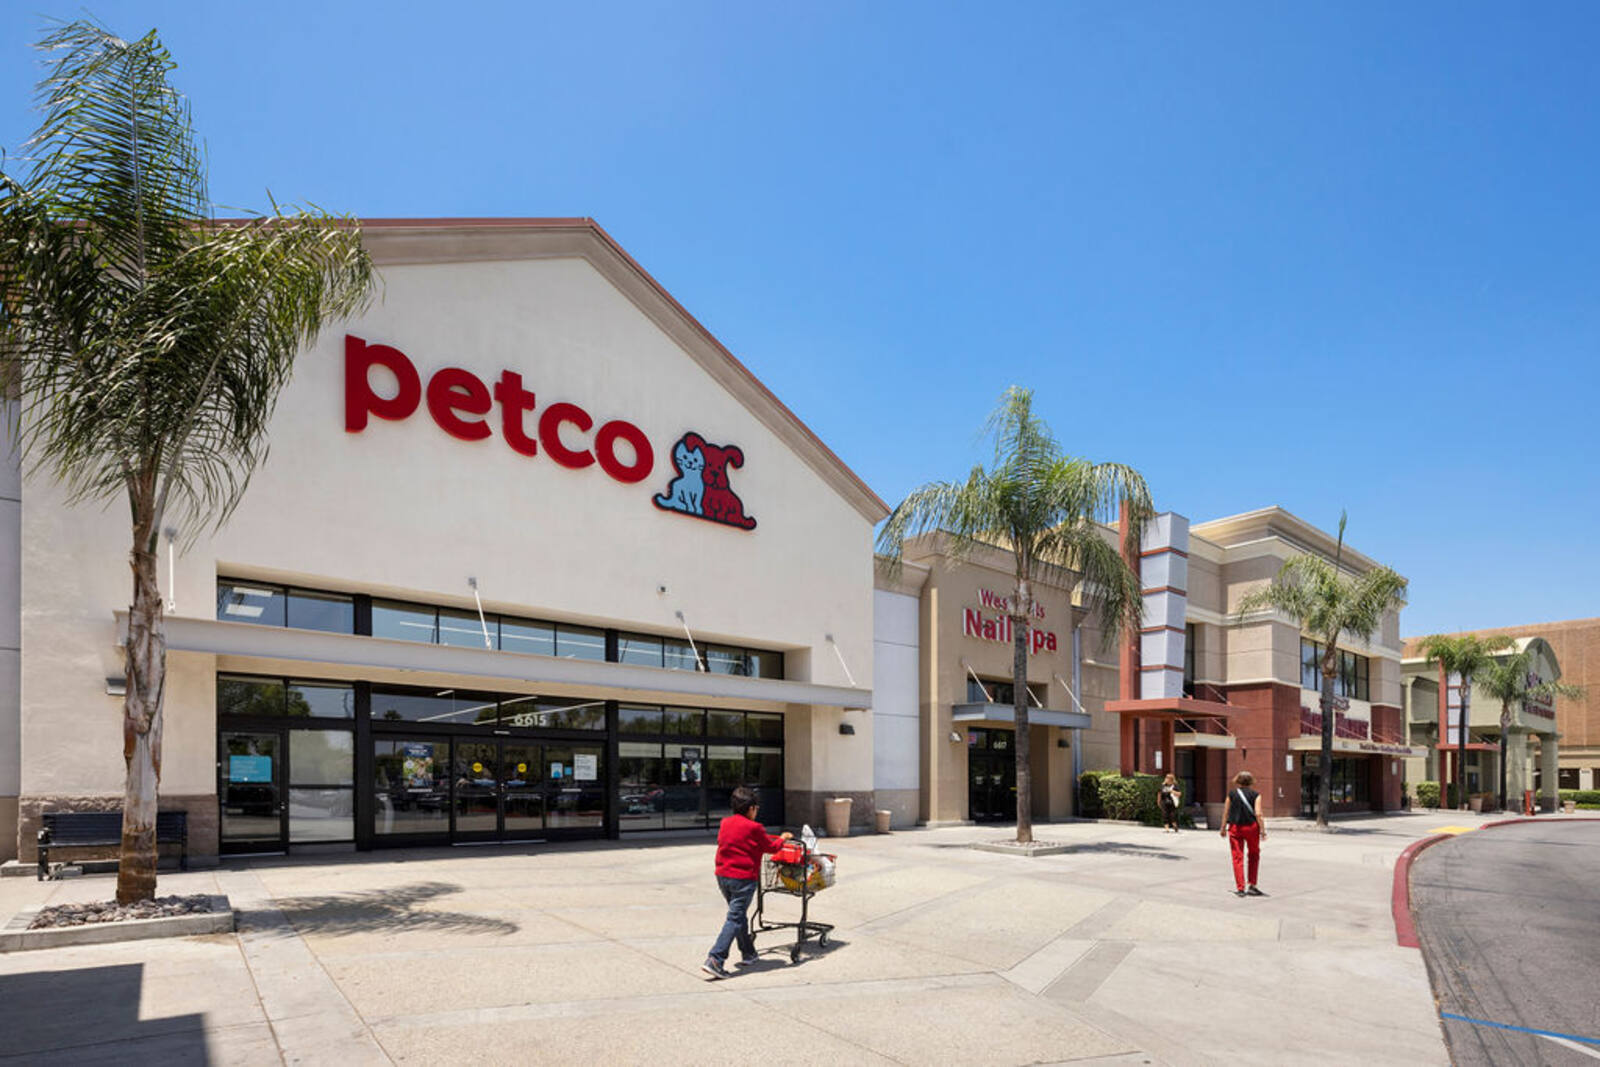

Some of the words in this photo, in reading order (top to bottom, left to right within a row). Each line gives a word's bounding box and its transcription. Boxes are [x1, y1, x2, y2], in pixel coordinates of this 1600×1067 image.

[345, 334, 654, 484] petco
[978, 588, 1012, 613] Wes
[963, 608, 1012, 643] Nail
[1025, 620, 1056, 655] pa
[514, 714, 547, 727] 6615
